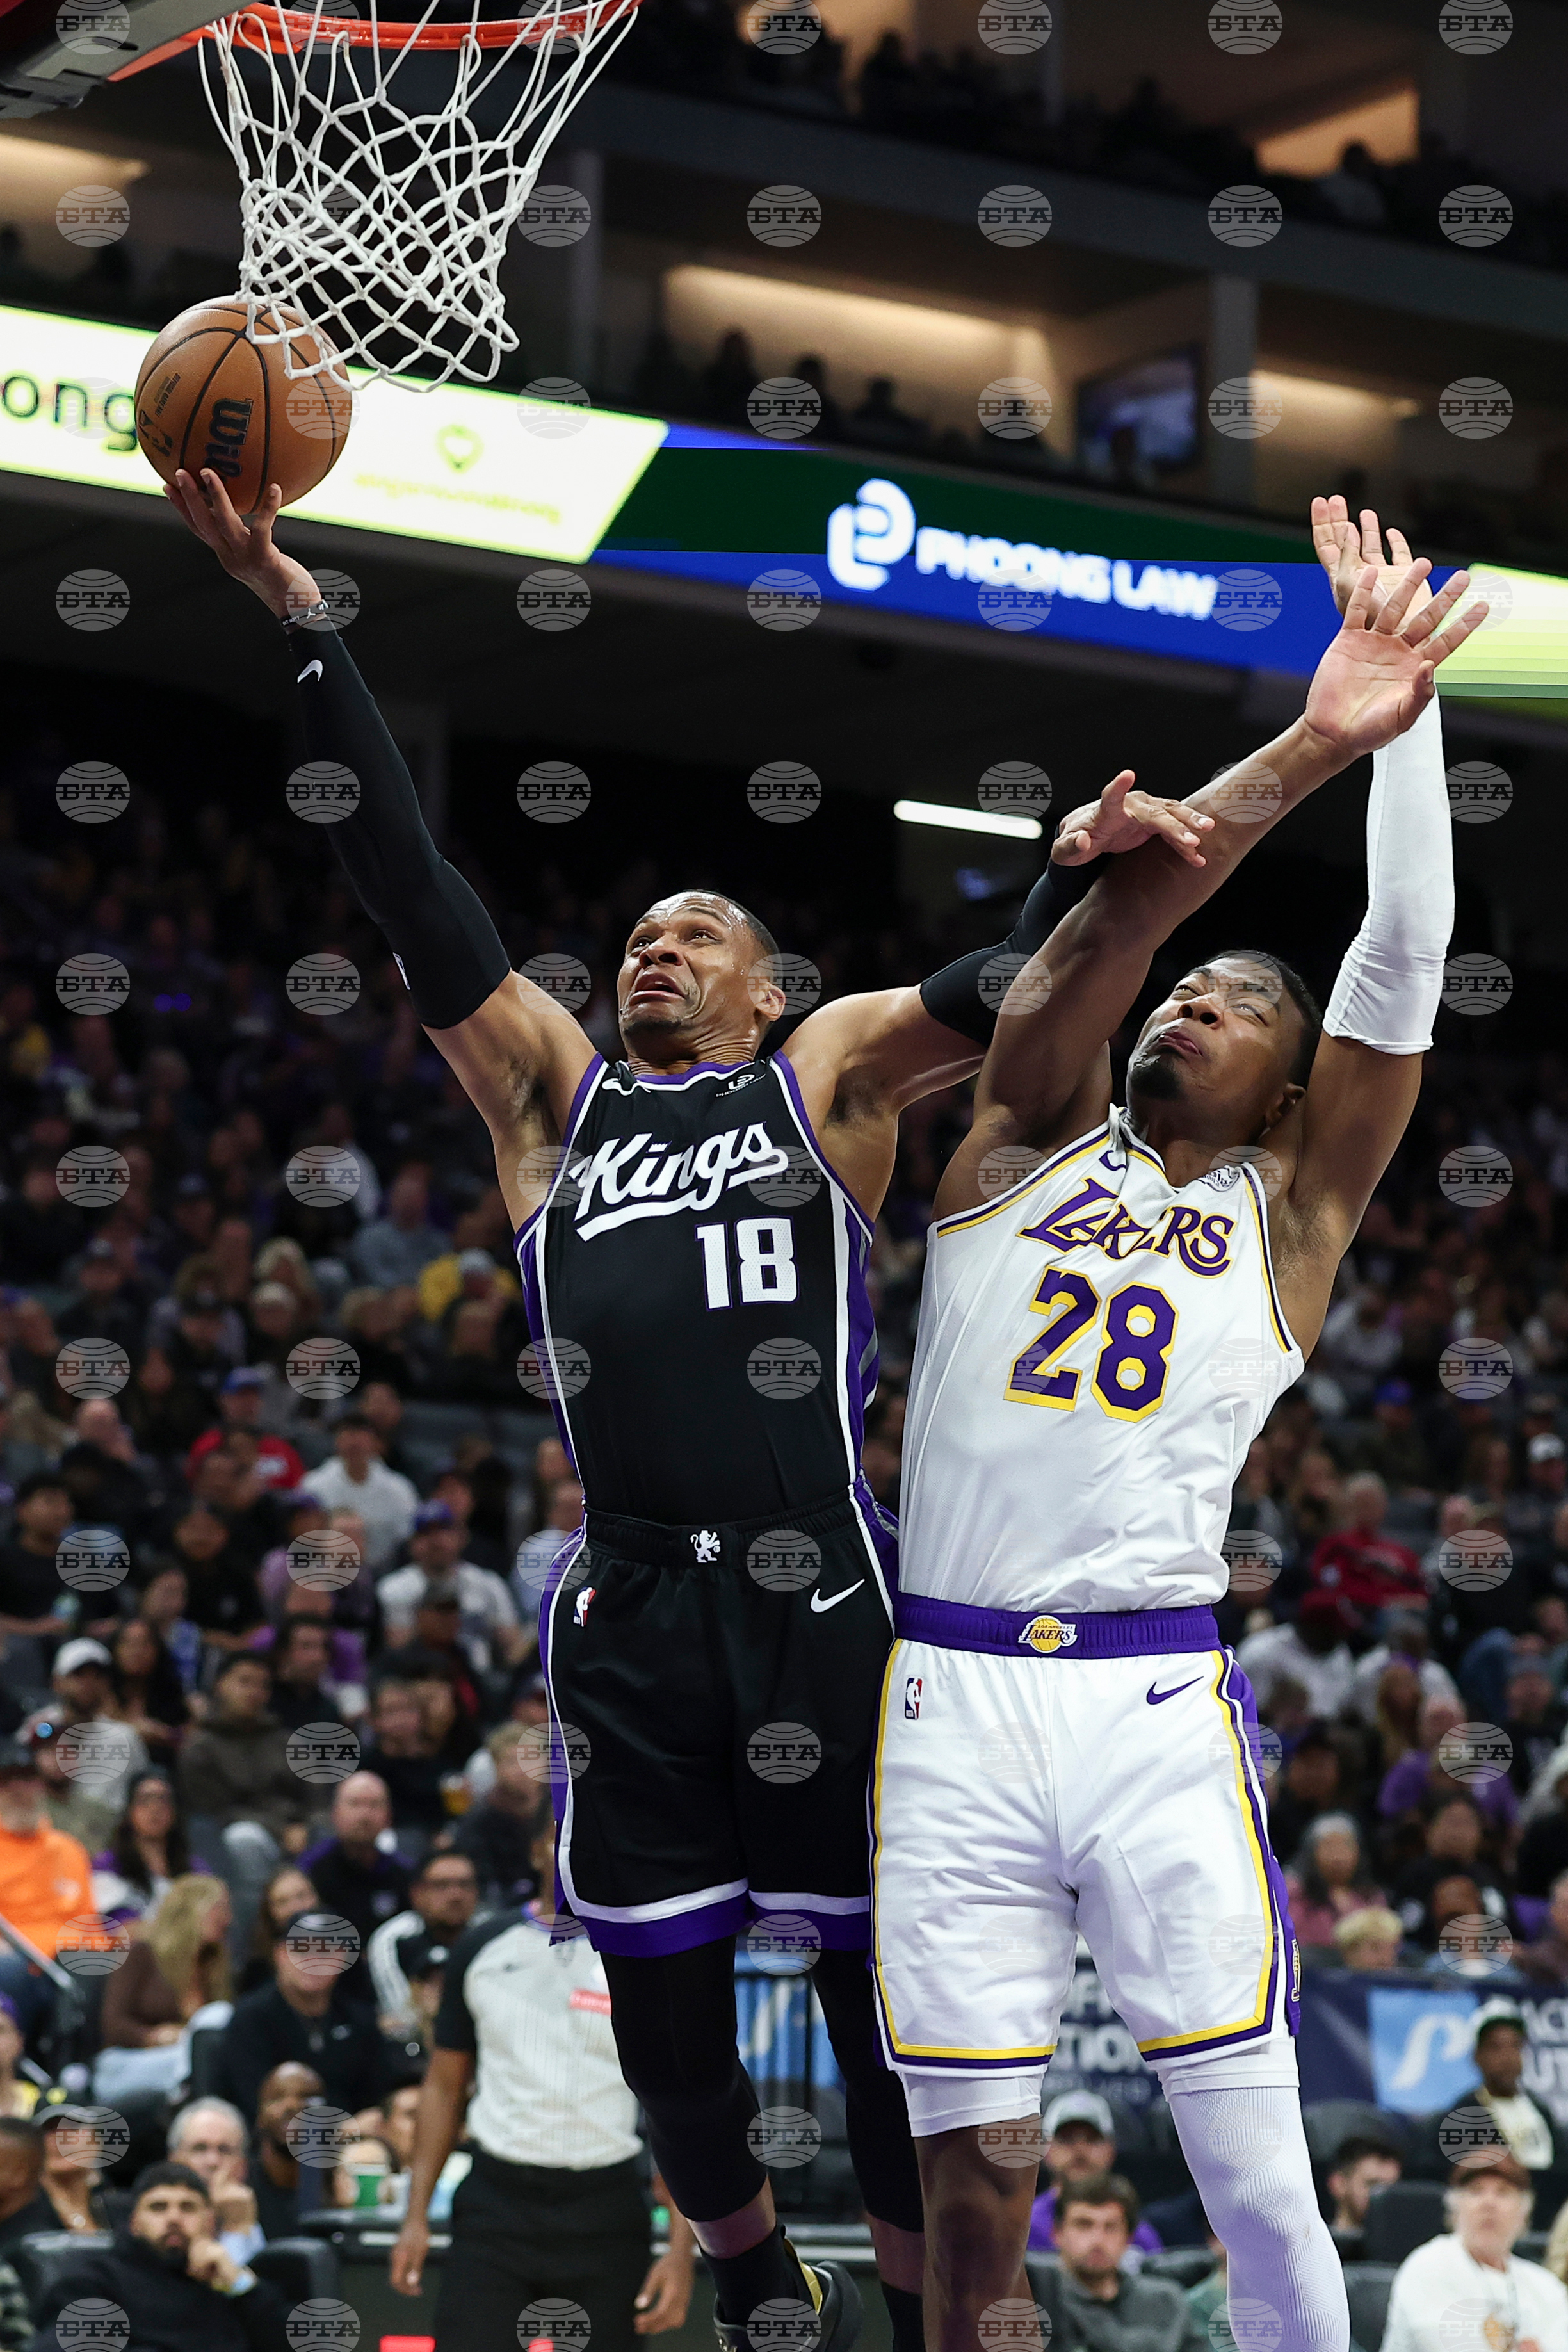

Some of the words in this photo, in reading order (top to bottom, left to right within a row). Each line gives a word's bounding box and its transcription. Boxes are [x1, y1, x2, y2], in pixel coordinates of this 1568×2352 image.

[204, 397, 254, 478] Wil
[1113, 559, 1218, 621] LAW
[568, 1121, 789, 1242] Kings
[695, 1216, 800, 1311] 18
[1003, 1265, 1179, 1423] 28
[1022, 1625, 1072, 1644] LAKERS
